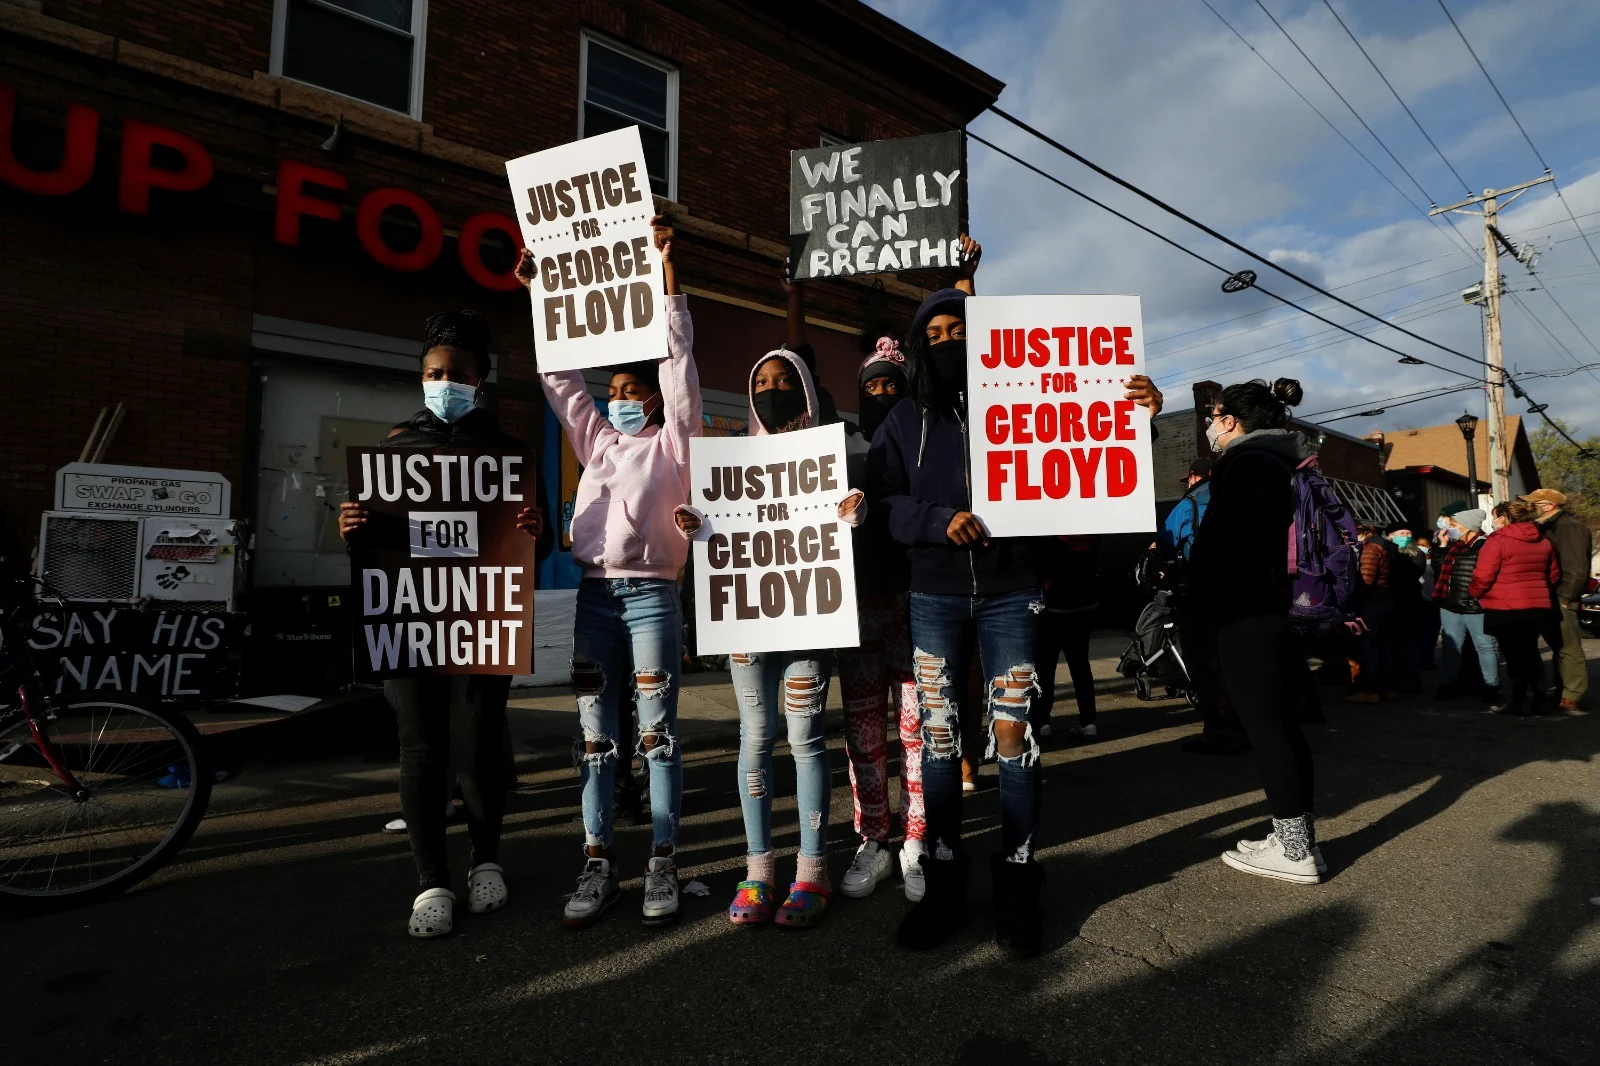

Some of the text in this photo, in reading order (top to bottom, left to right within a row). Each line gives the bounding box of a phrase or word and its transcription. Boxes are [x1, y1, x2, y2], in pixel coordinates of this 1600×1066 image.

[799, 147, 862, 188] WE
[526, 162, 643, 226] JUSTICE
[801, 170, 960, 231] FINALLY
[572, 217, 602, 242] FOR
[827, 213, 908, 250] CAN
[540, 236, 652, 293] GEORGE
[810, 237, 961, 278] BREATHE
[543, 281, 654, 342] FLOYD
[980, 326, 1135, 369] JUSTICE
[1041, 372, 1078, 394] FOR
[985, 400, 1136, 445] GEORGE
[75, 484, 145, 501] SWAP
[179, 490, 212, 505] GO
[111, 477, 181, 488] PROPANE GAS
[358, 453, 524, 503] JUSTICE
[702, 454, 838, 502] JUSTICE
[986, 446, 1138, 502] FLOYD
[87, 501, 200, 514] EXCHANGE CYLINDERS
[757, 502, 789, 523] FOR
[420, 519, 469, 548] FOR
[707, 522, 840, 570] GEORGE
[362, 566, 524, 617] DAUNTE
[709, 566, 843, 622] FLOYD
[26, 609, 225, 650] SAY HIS
[286, 631, 333, 641] StarTribune
[363, 619, 523, 672] WRIGHT
[55, 653, 206, 696] NAME
